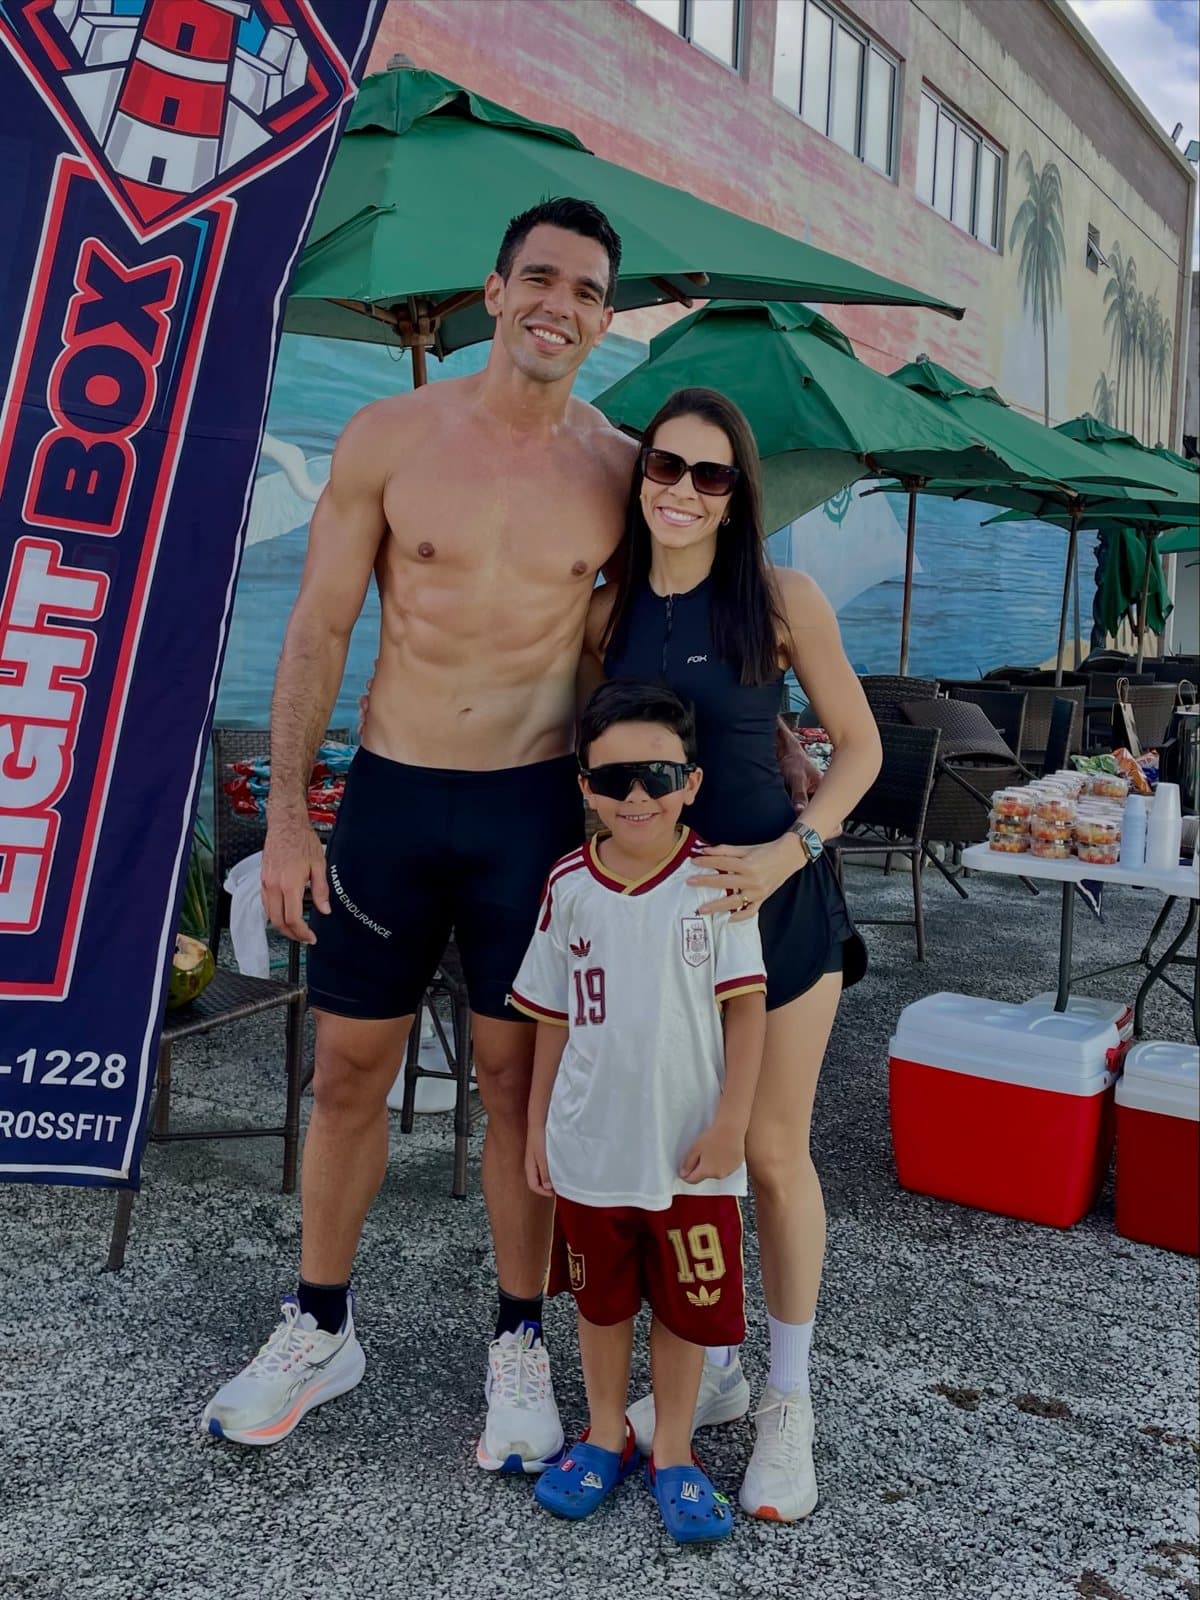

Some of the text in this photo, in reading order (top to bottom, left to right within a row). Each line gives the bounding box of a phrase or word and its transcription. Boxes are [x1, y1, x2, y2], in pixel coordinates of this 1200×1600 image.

[23, 237, 182, 536] BOX
[573, 967, 607, 1027] 19
[0, 1048, 127, 1089] -1228
[667, 1223, 726, 1283] 19
